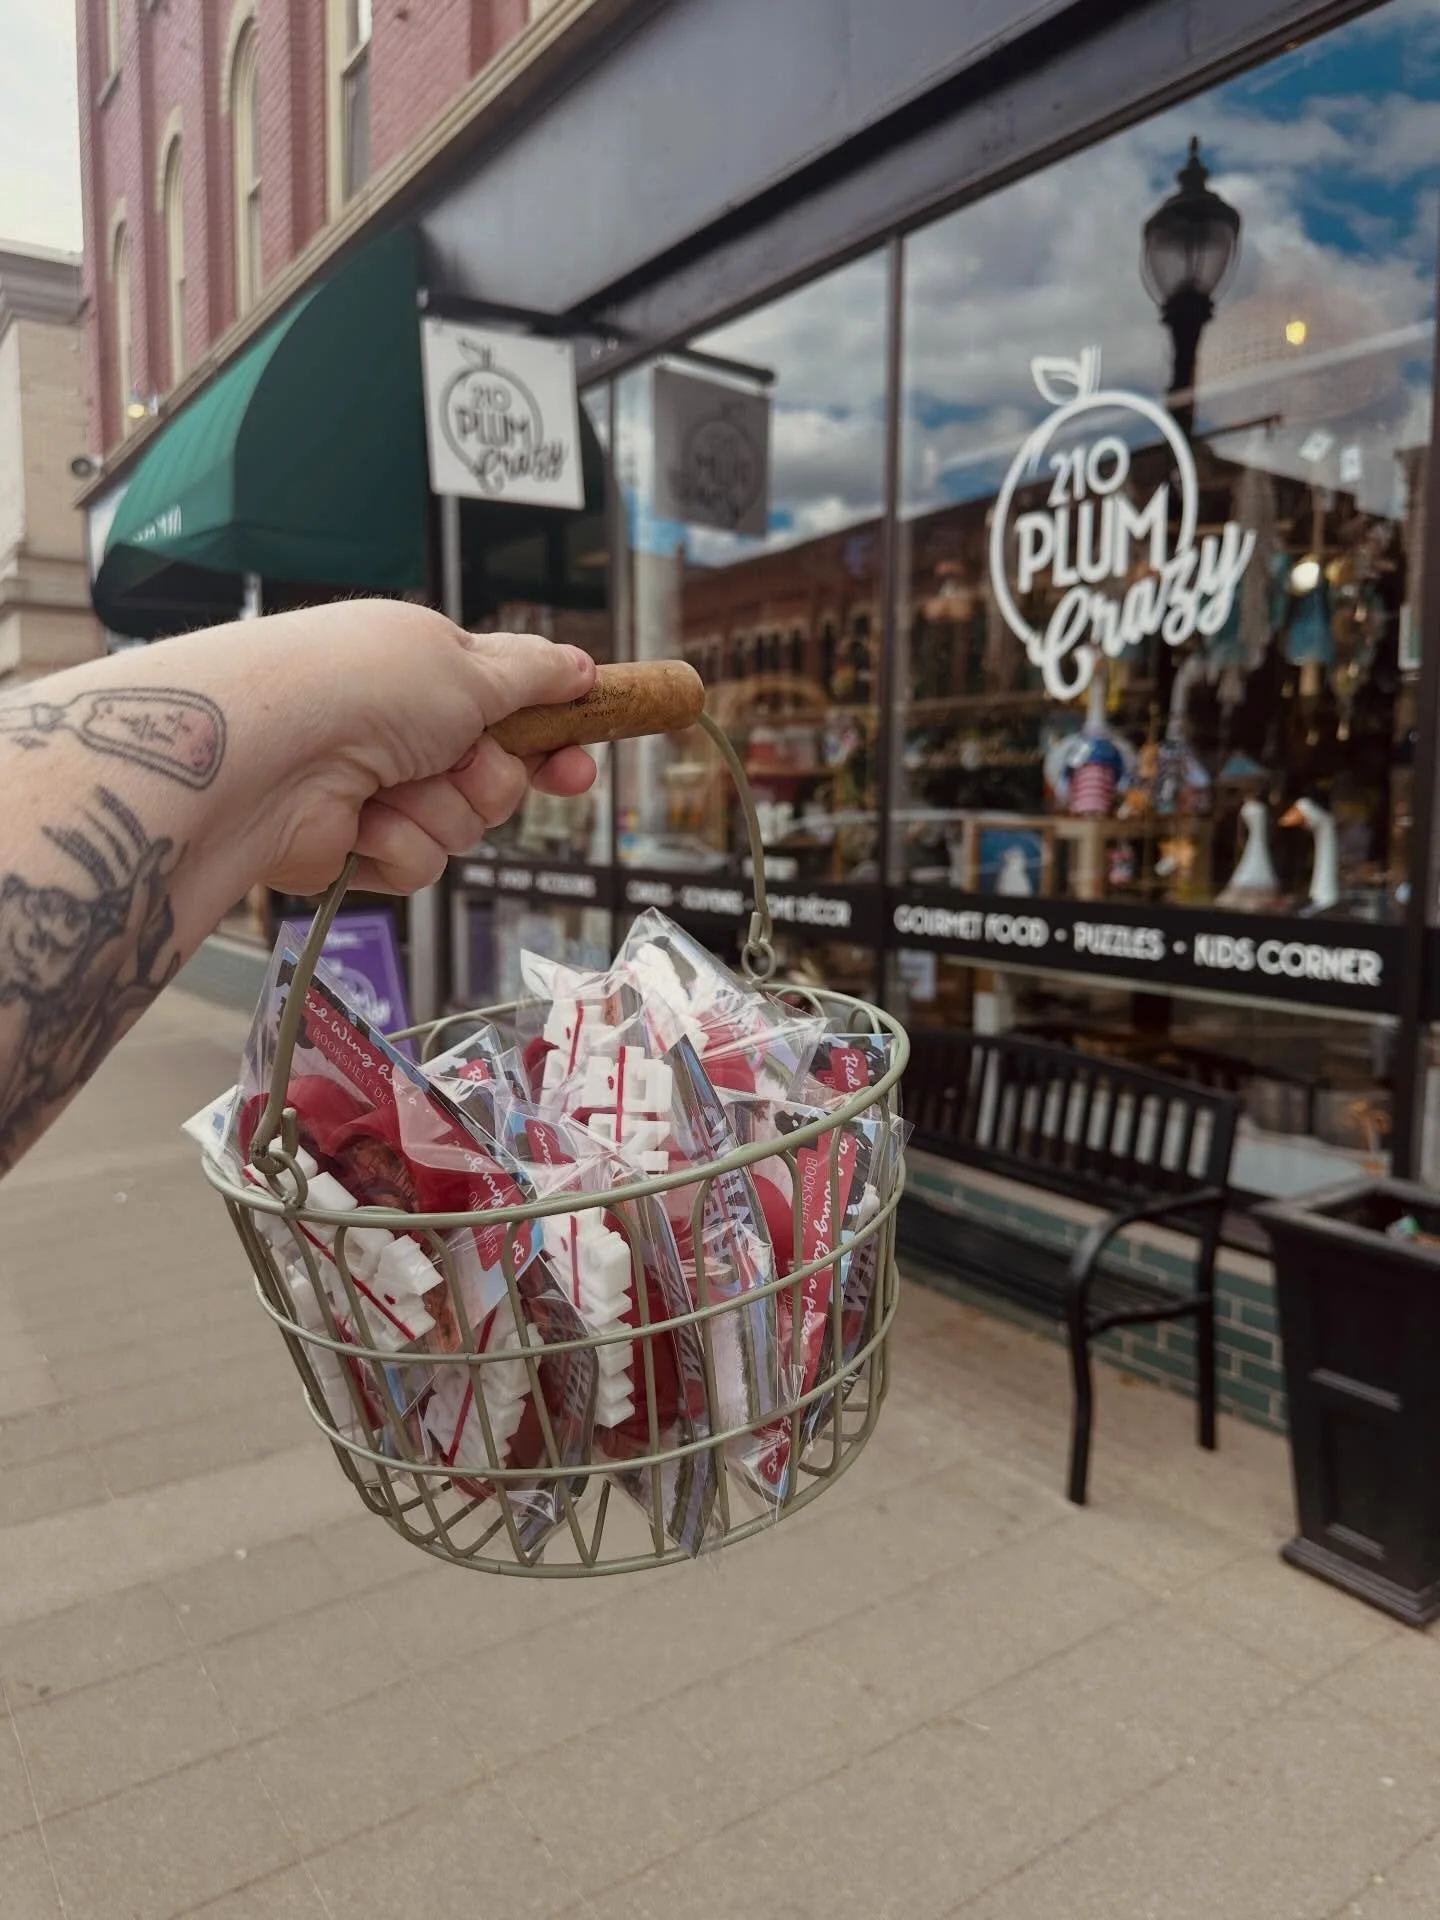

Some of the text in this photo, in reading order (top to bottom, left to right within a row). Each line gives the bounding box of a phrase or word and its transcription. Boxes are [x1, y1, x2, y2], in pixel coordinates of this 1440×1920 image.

[472, 384, 513, 413] 210
[455, 404, 532, 448] PLUM
[1048, 436, 1131, 508] 210
[1014, 481, 1170, 594] PLUM
[1026, 521, 1258, 701] Crazy
[893, 903, 1050, 948] GOURMET FOOD
[1072, 920, 1165, 962] PUZZLES
[1193, 932, 1384, 987] KIDS CORNER
[330, 1020, 376, 1068] Wing
[841, 1053, 862, 1089] Red
